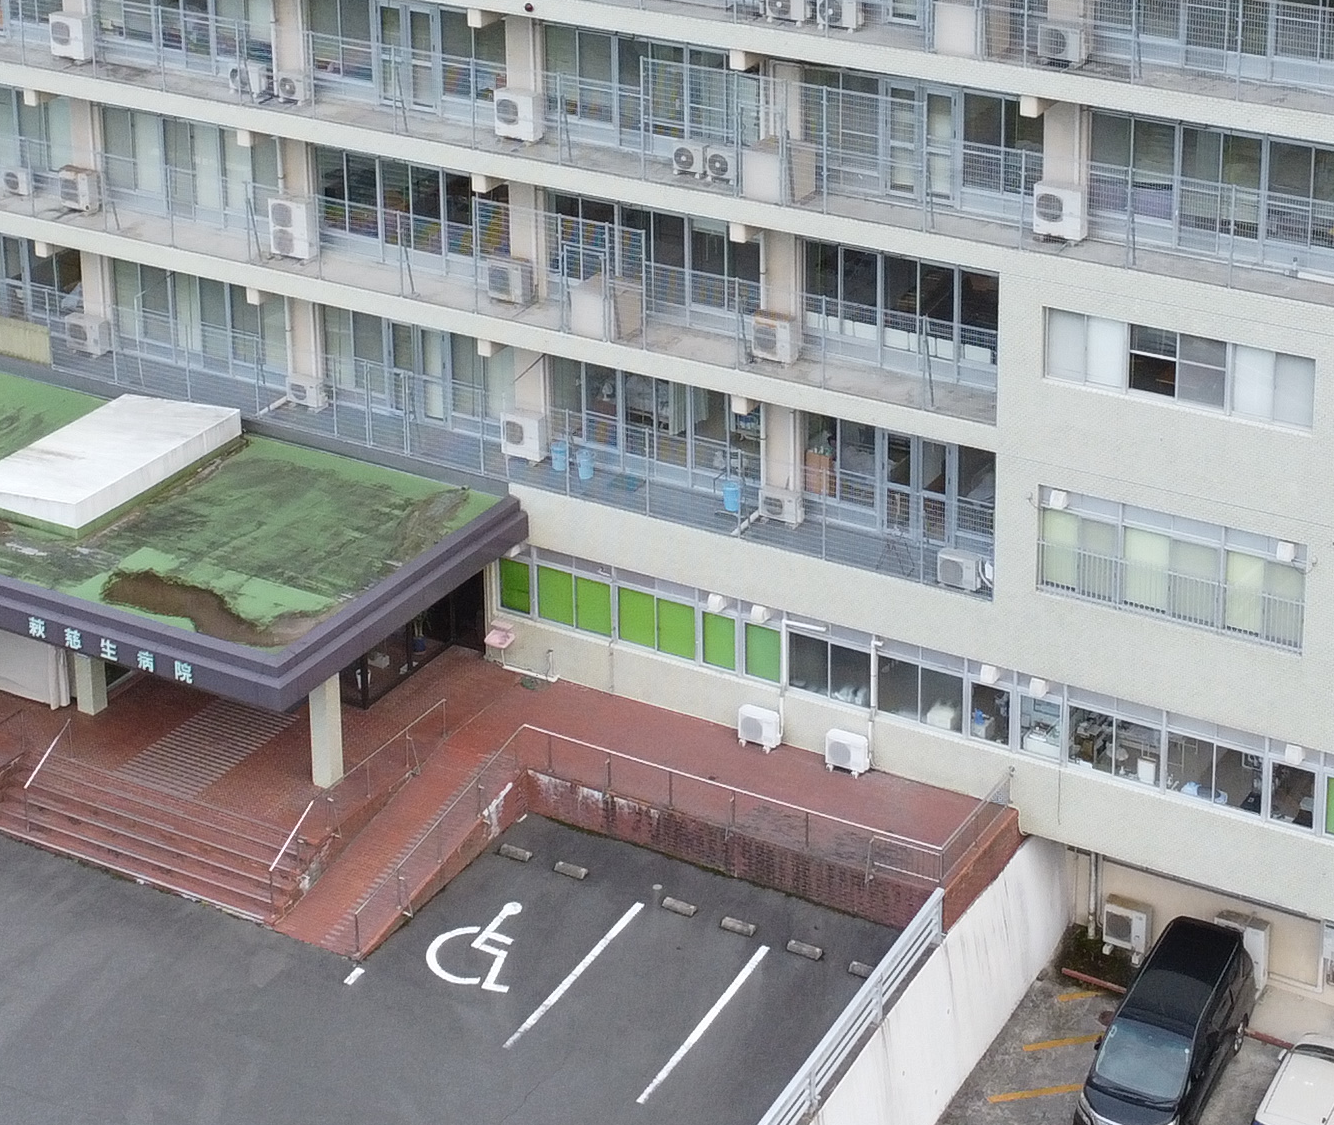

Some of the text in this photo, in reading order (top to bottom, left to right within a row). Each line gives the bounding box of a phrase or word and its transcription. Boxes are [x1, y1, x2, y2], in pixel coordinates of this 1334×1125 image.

[28, 616, 193, 684] 萩慈生病院
